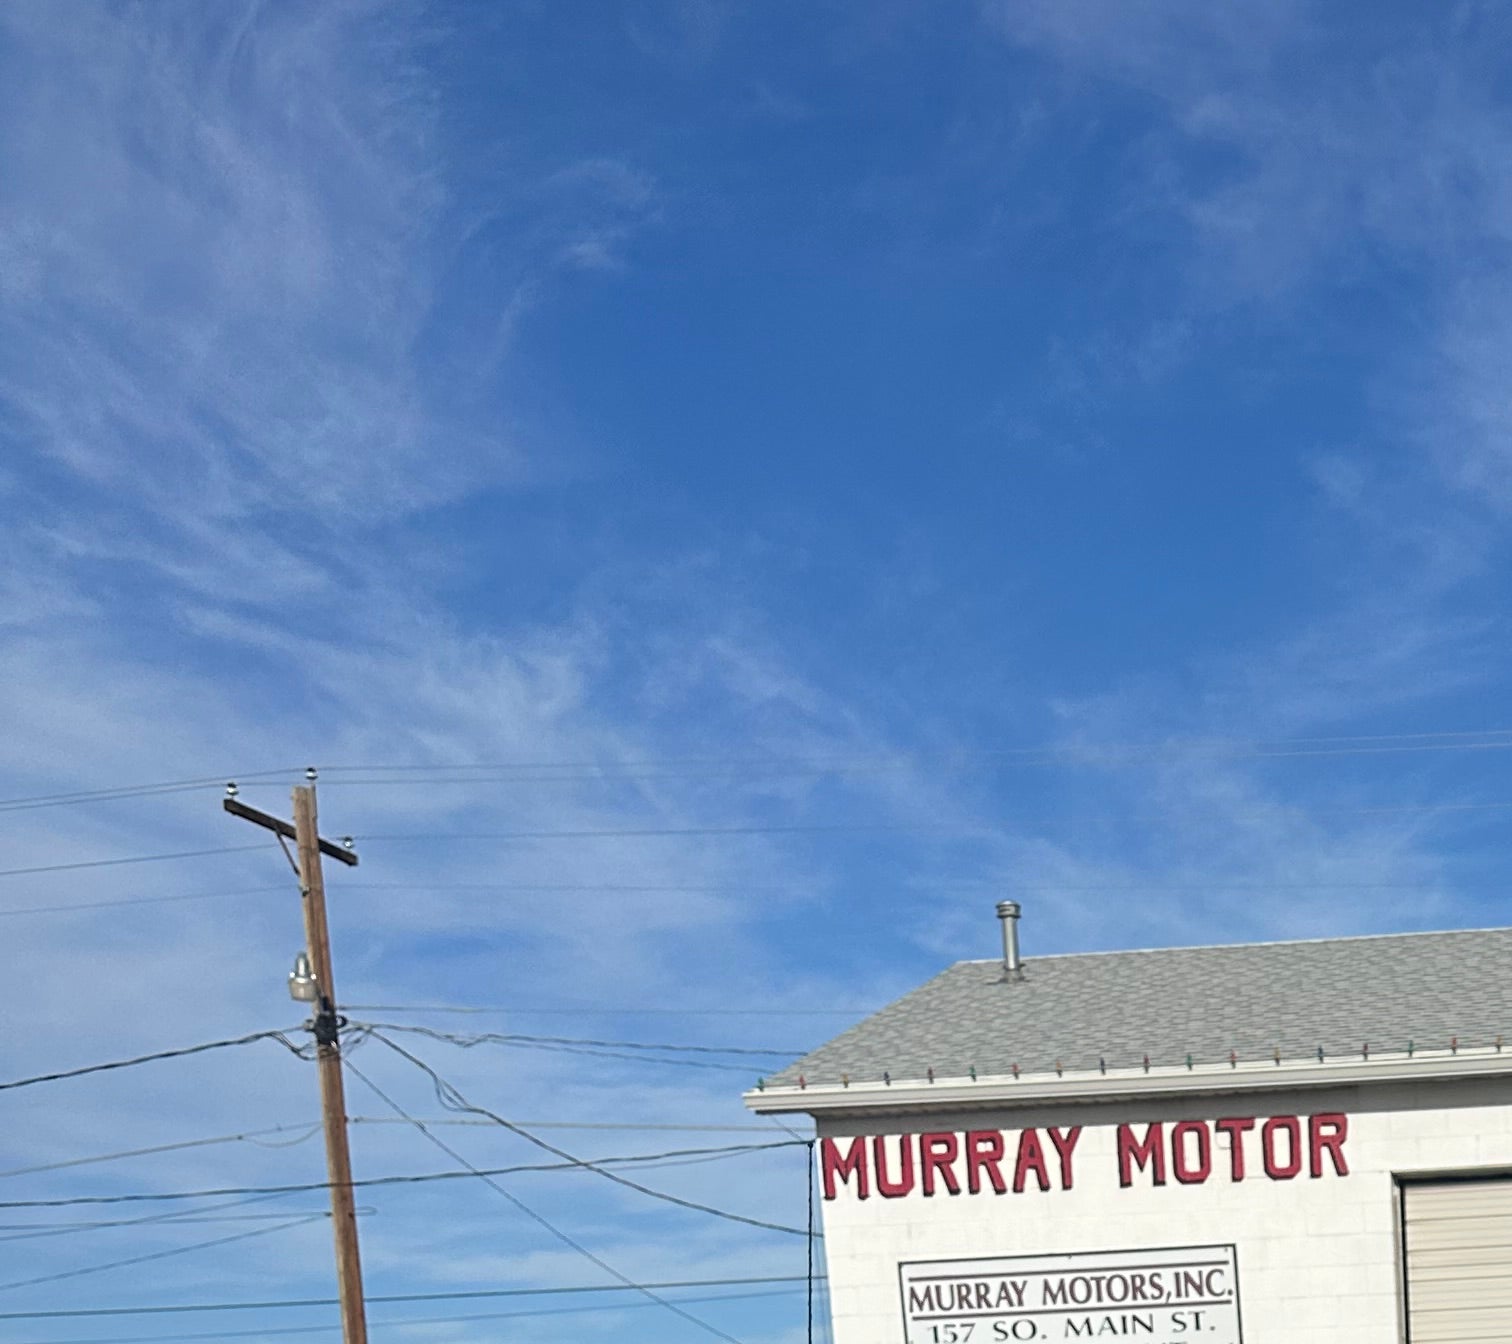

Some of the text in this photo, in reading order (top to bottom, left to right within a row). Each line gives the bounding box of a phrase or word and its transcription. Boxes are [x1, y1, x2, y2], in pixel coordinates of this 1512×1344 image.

[820, 1113, 1349, 1199] MURRAY MOTOR
[909, 1280, 1028, 1313] MURRAY
[929, 1310, 1216, 1344] 157 SO. MAIN ST.
